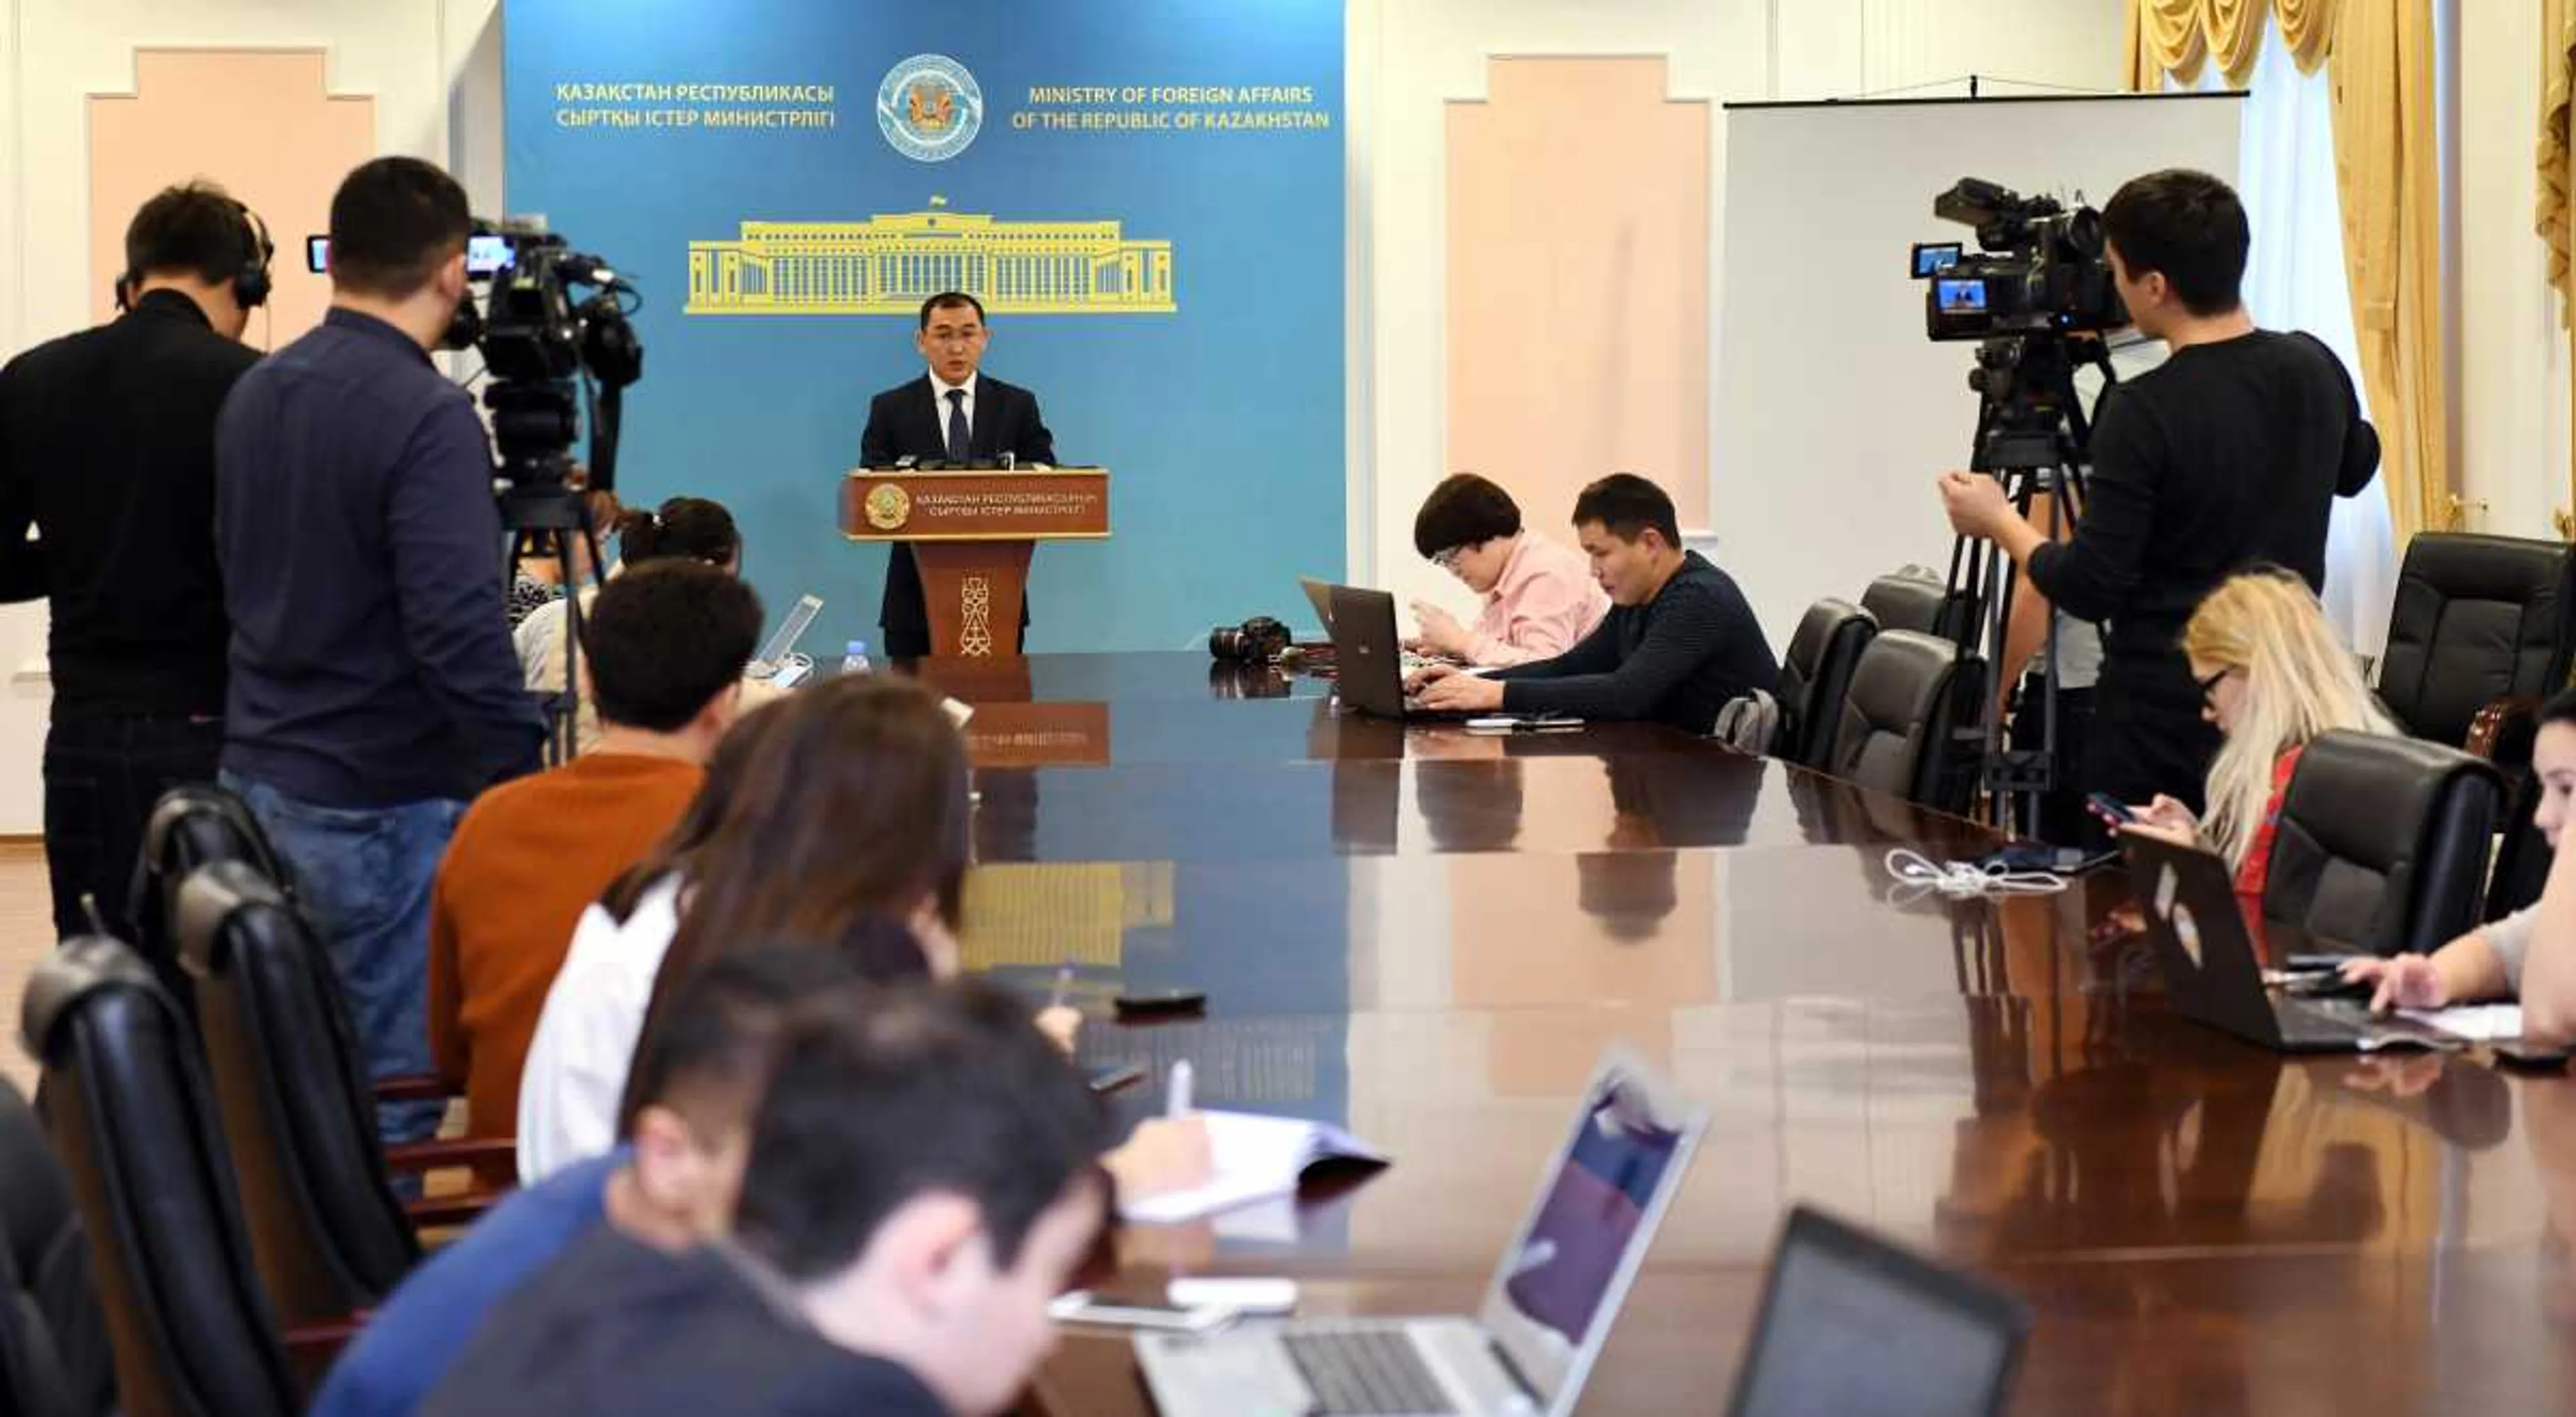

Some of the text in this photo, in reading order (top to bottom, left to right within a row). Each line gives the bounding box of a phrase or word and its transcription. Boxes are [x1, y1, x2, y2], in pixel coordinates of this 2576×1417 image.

[557, 83, 835, 103] ҚАЗАҚСТАН РЕСПУБЛИКАСЫ
[1029, 86, 1313, 103] MINISTRY OF FOREIGN AFFAIRS
[555, 109, 835, 129] СЫРТҚЫ ІСТЕР МИНИСТРЛІГІ
[1012, 111, 1330, 129] OF THE REPUBLIC OF KAZAKHSTAN
